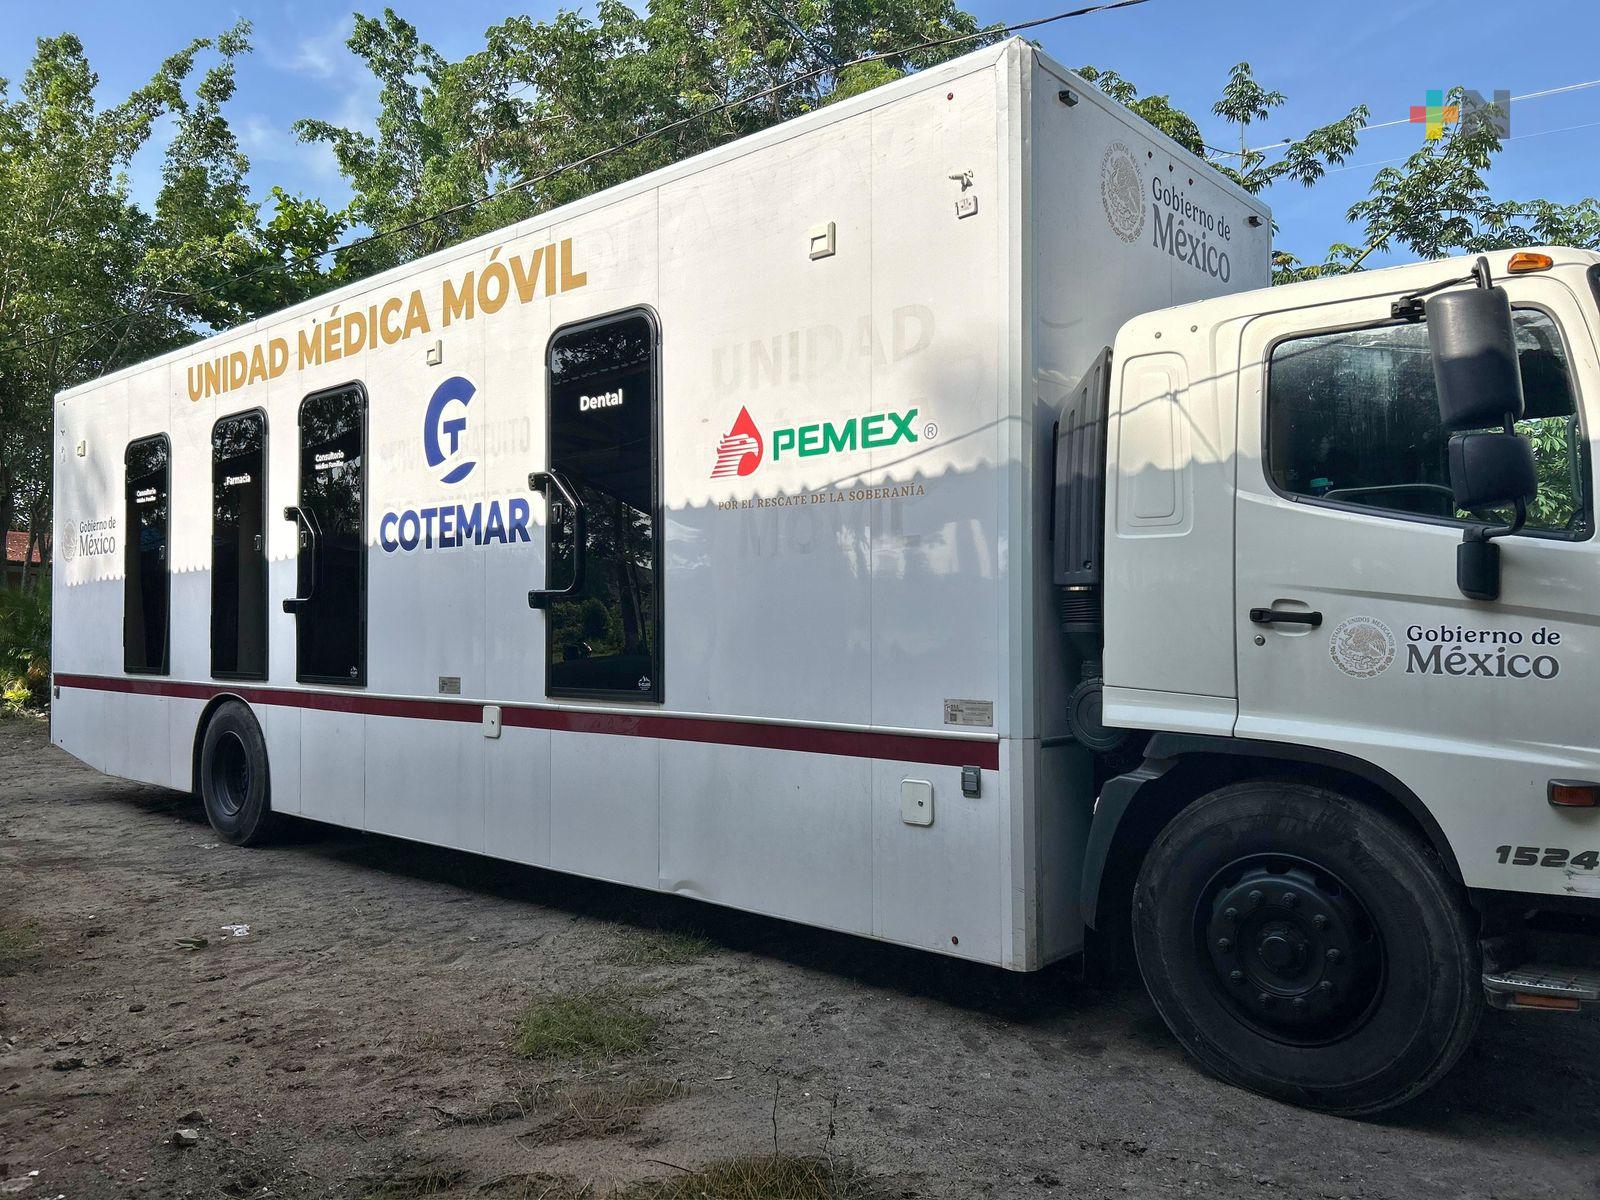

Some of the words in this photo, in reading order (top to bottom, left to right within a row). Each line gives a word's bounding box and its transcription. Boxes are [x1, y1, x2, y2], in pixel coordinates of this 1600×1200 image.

[1152, 176, 1214, 232] Gobierno
[1217, 215, 1231, 242] de
[187, 337, 289, 402] UNIDAD
[298, 290, 430, 371] MÉDICA
[442, 237, 588, 328] MÓVIL
[579, 388, 623, 411] Dental
[773, 408, 918, 461] PEMEX
[718, 501, 738, 511] POR
[741, 499, 754, 509] EL
[757, 495, 807, 508] RESCATE
[811, 493, 826, 504] DE
[829, 491, 844, 502] LA
[849, 483, 925, 501] SOBERANÍA
[80, 520, 108, 533] Gobierno
[109, 516, 116, 530] de
[380, 498, 531, 553] COTEMAR
[79, 533, 116, 557] México
[1406, 625, 1523, 645] Gobierno
[1531, 628, 1561, 645] de
[1405, 644, 1560, 680] México
[1495, 846, 1600, 871] 1524
